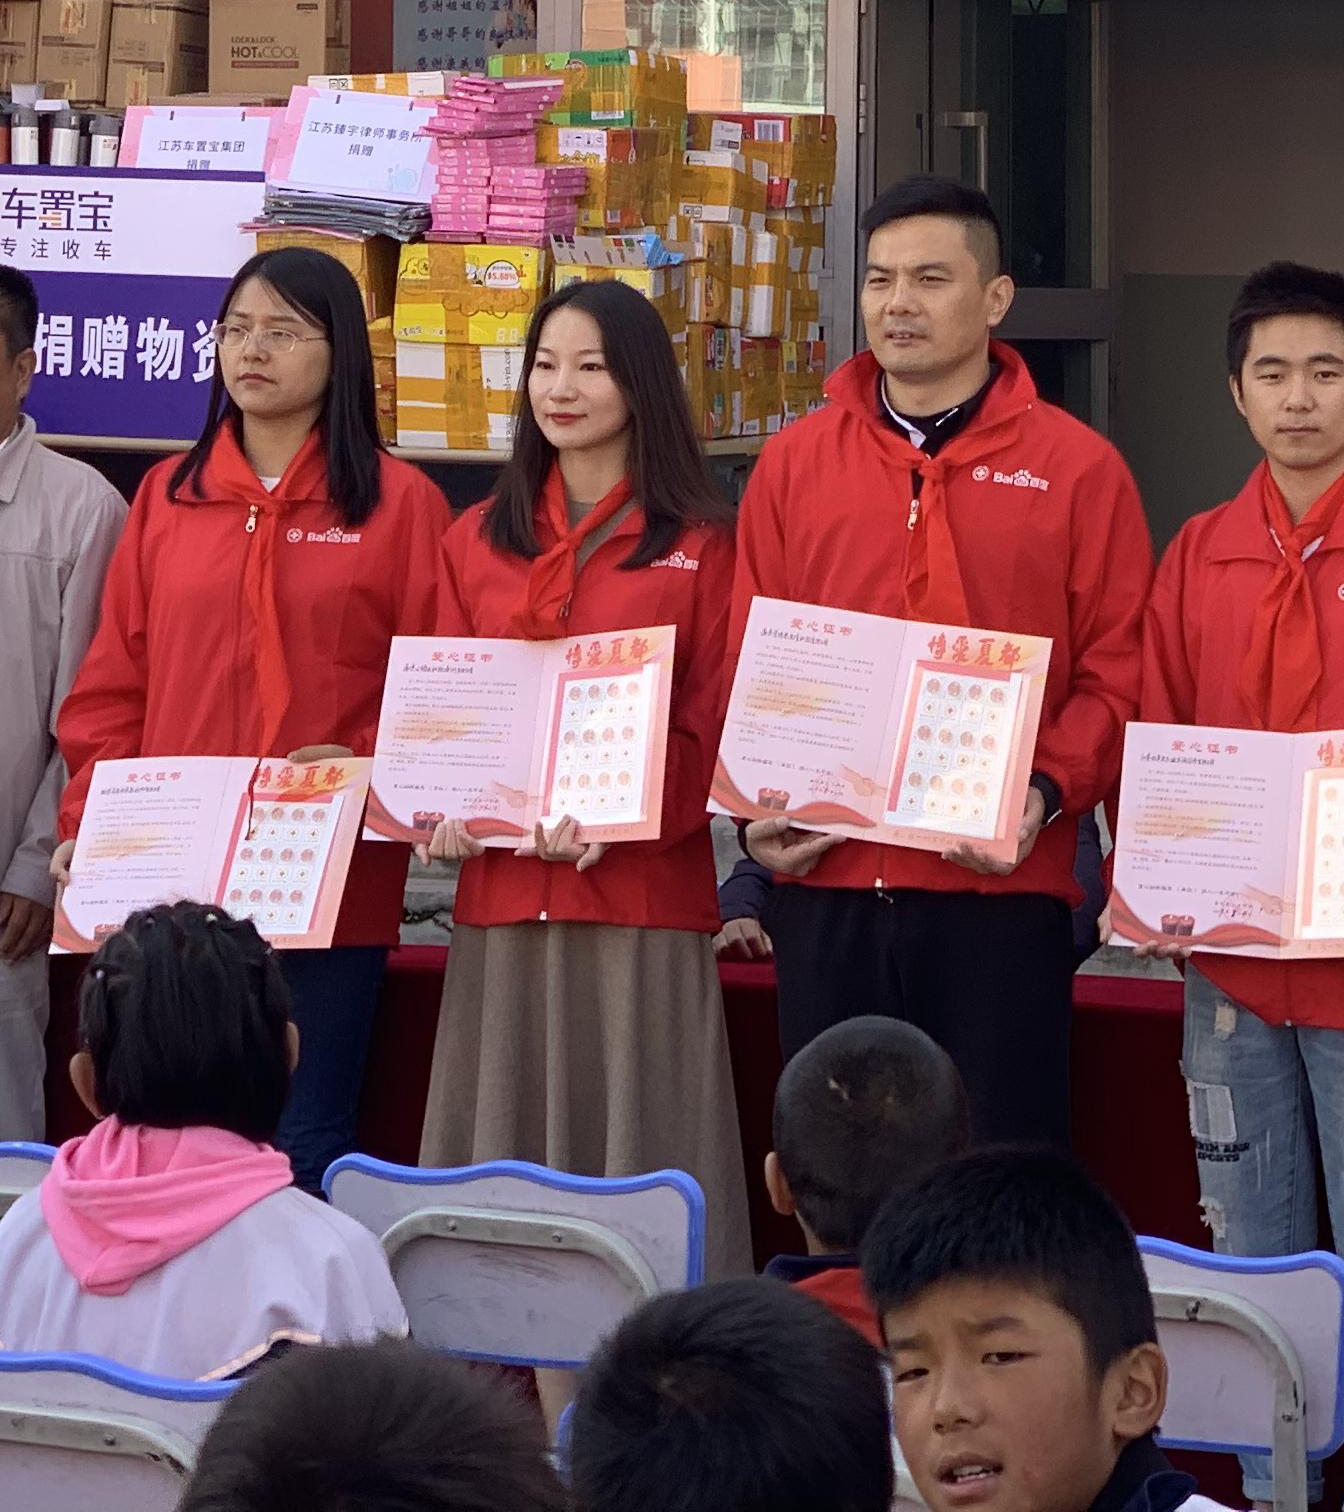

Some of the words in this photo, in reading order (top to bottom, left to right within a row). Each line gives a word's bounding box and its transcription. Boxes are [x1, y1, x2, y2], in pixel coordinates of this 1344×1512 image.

[158, 139, 245, 153] 江苏车置宝集团
[348, 143, 374, 157] 捐赠
[1, 187, 114, 233] 车置宝
[0, 236, 113, 261] 专注收车
[790, 618, 853, 636] 爱心证书
[431, 651, 494, 663] 爱心证书
[1171, 740, 1239, 755] 爱心证书
[126, 772, 182, 783] 爱心证书
